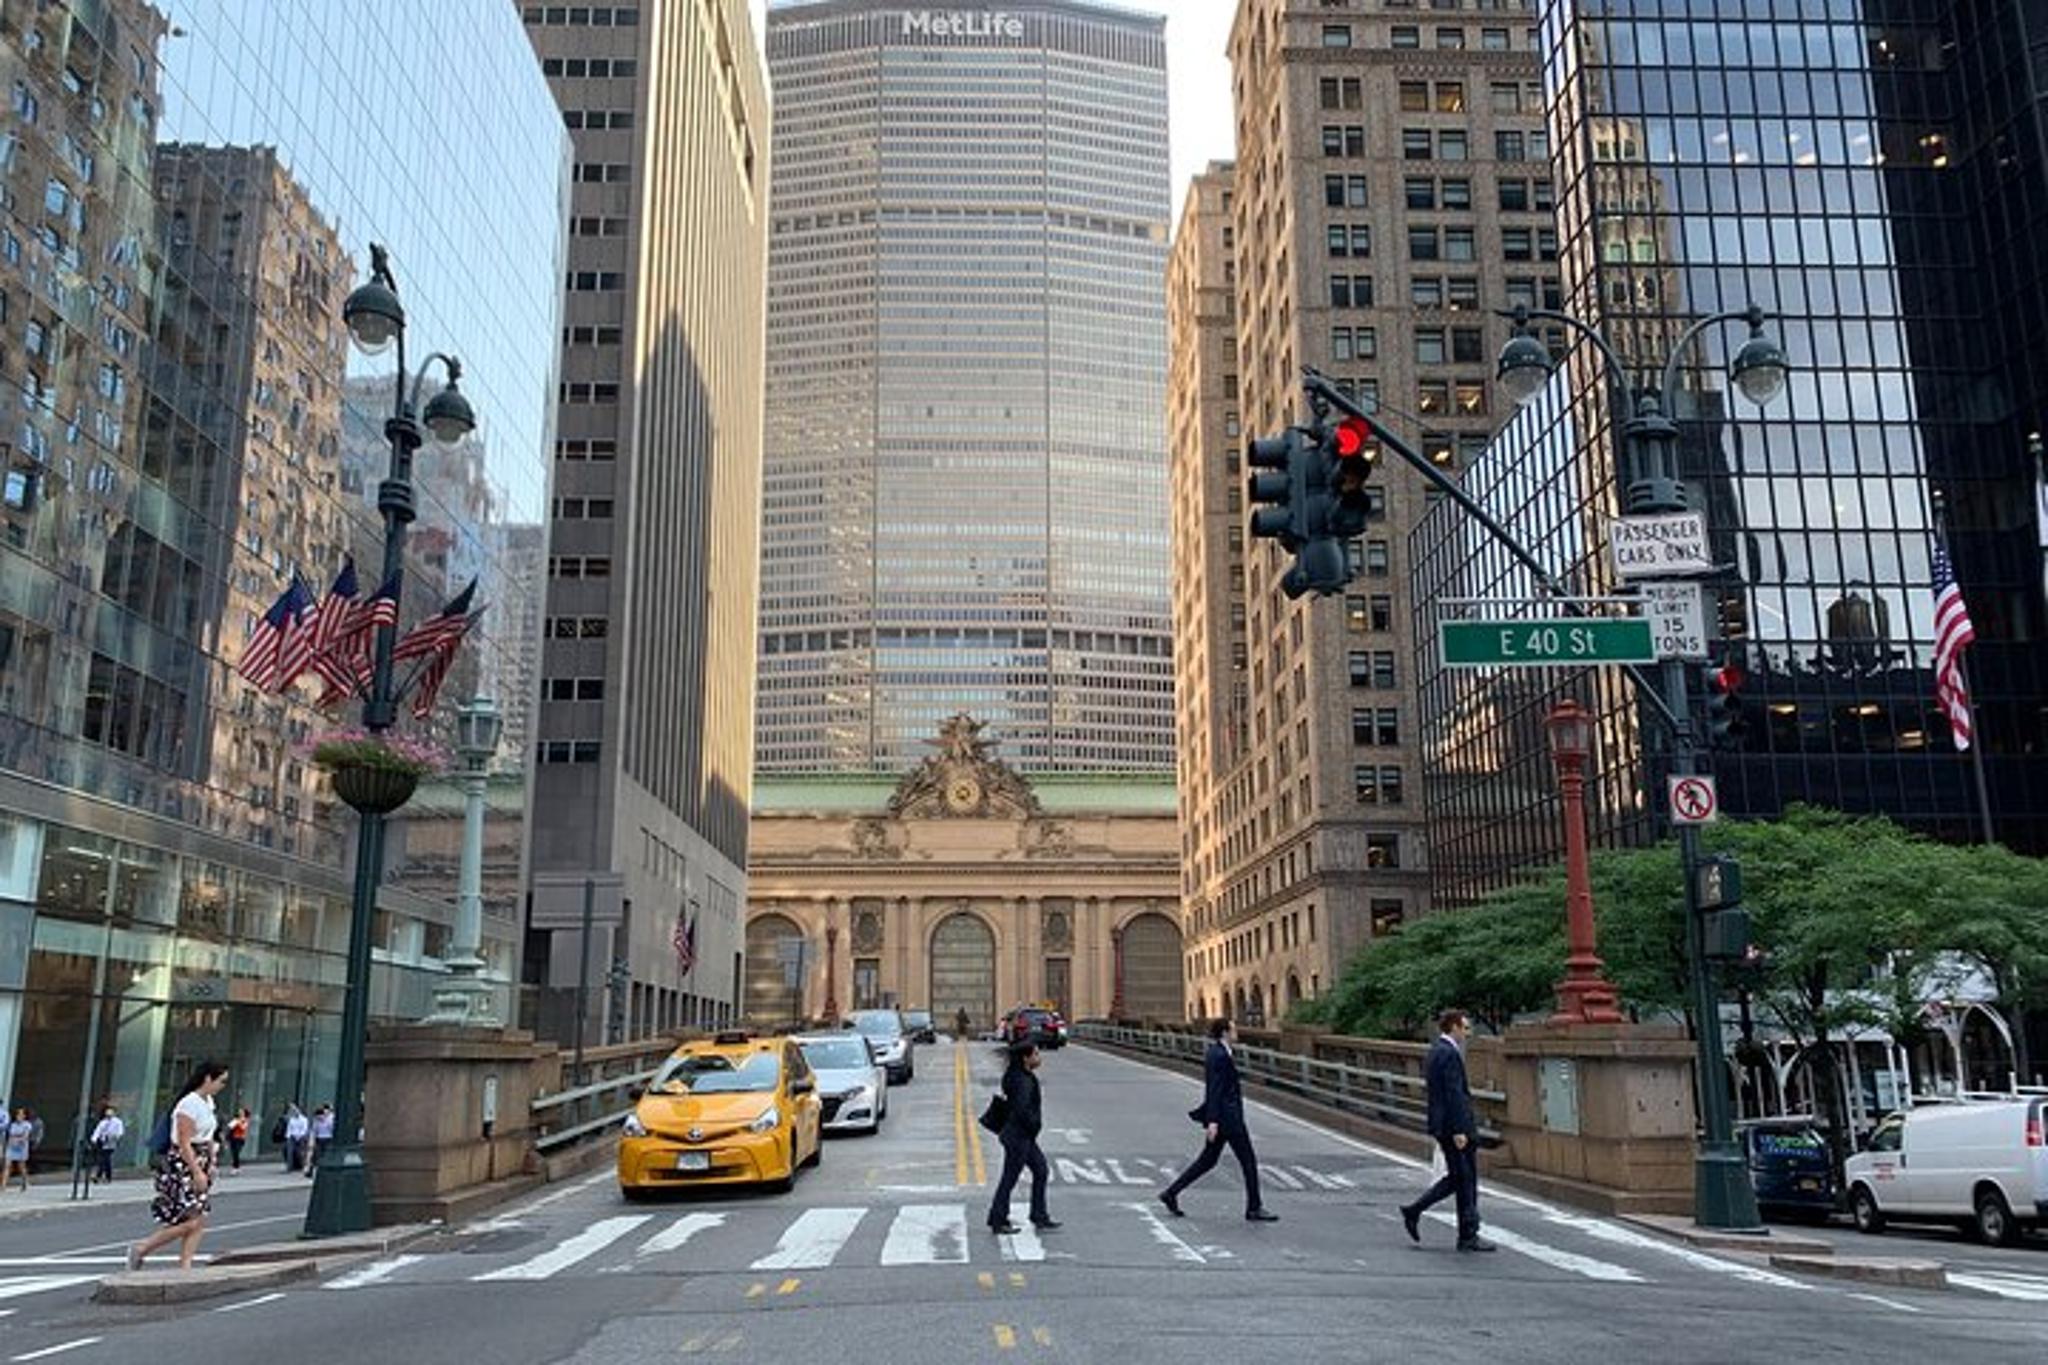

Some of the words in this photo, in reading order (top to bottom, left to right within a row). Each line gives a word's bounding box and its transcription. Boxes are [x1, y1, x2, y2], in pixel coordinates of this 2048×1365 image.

[903, 11, 1024, 37] MetLife
[1615, 520, 1699, 541] PASSENGER
[1618, 546, 1656, 565] CARS
[1665, 542, 1701, 562] ONLY
[1654, 602, 1688, 615] LIMIT
[1664, 617, 1685, 632] 15
[1500, 630, 1516, 655] E
[1526, 628, 1560, 655] 40
[1569, 627, 1597, 655] St
[1655, 635, 1700, 652] TONS
